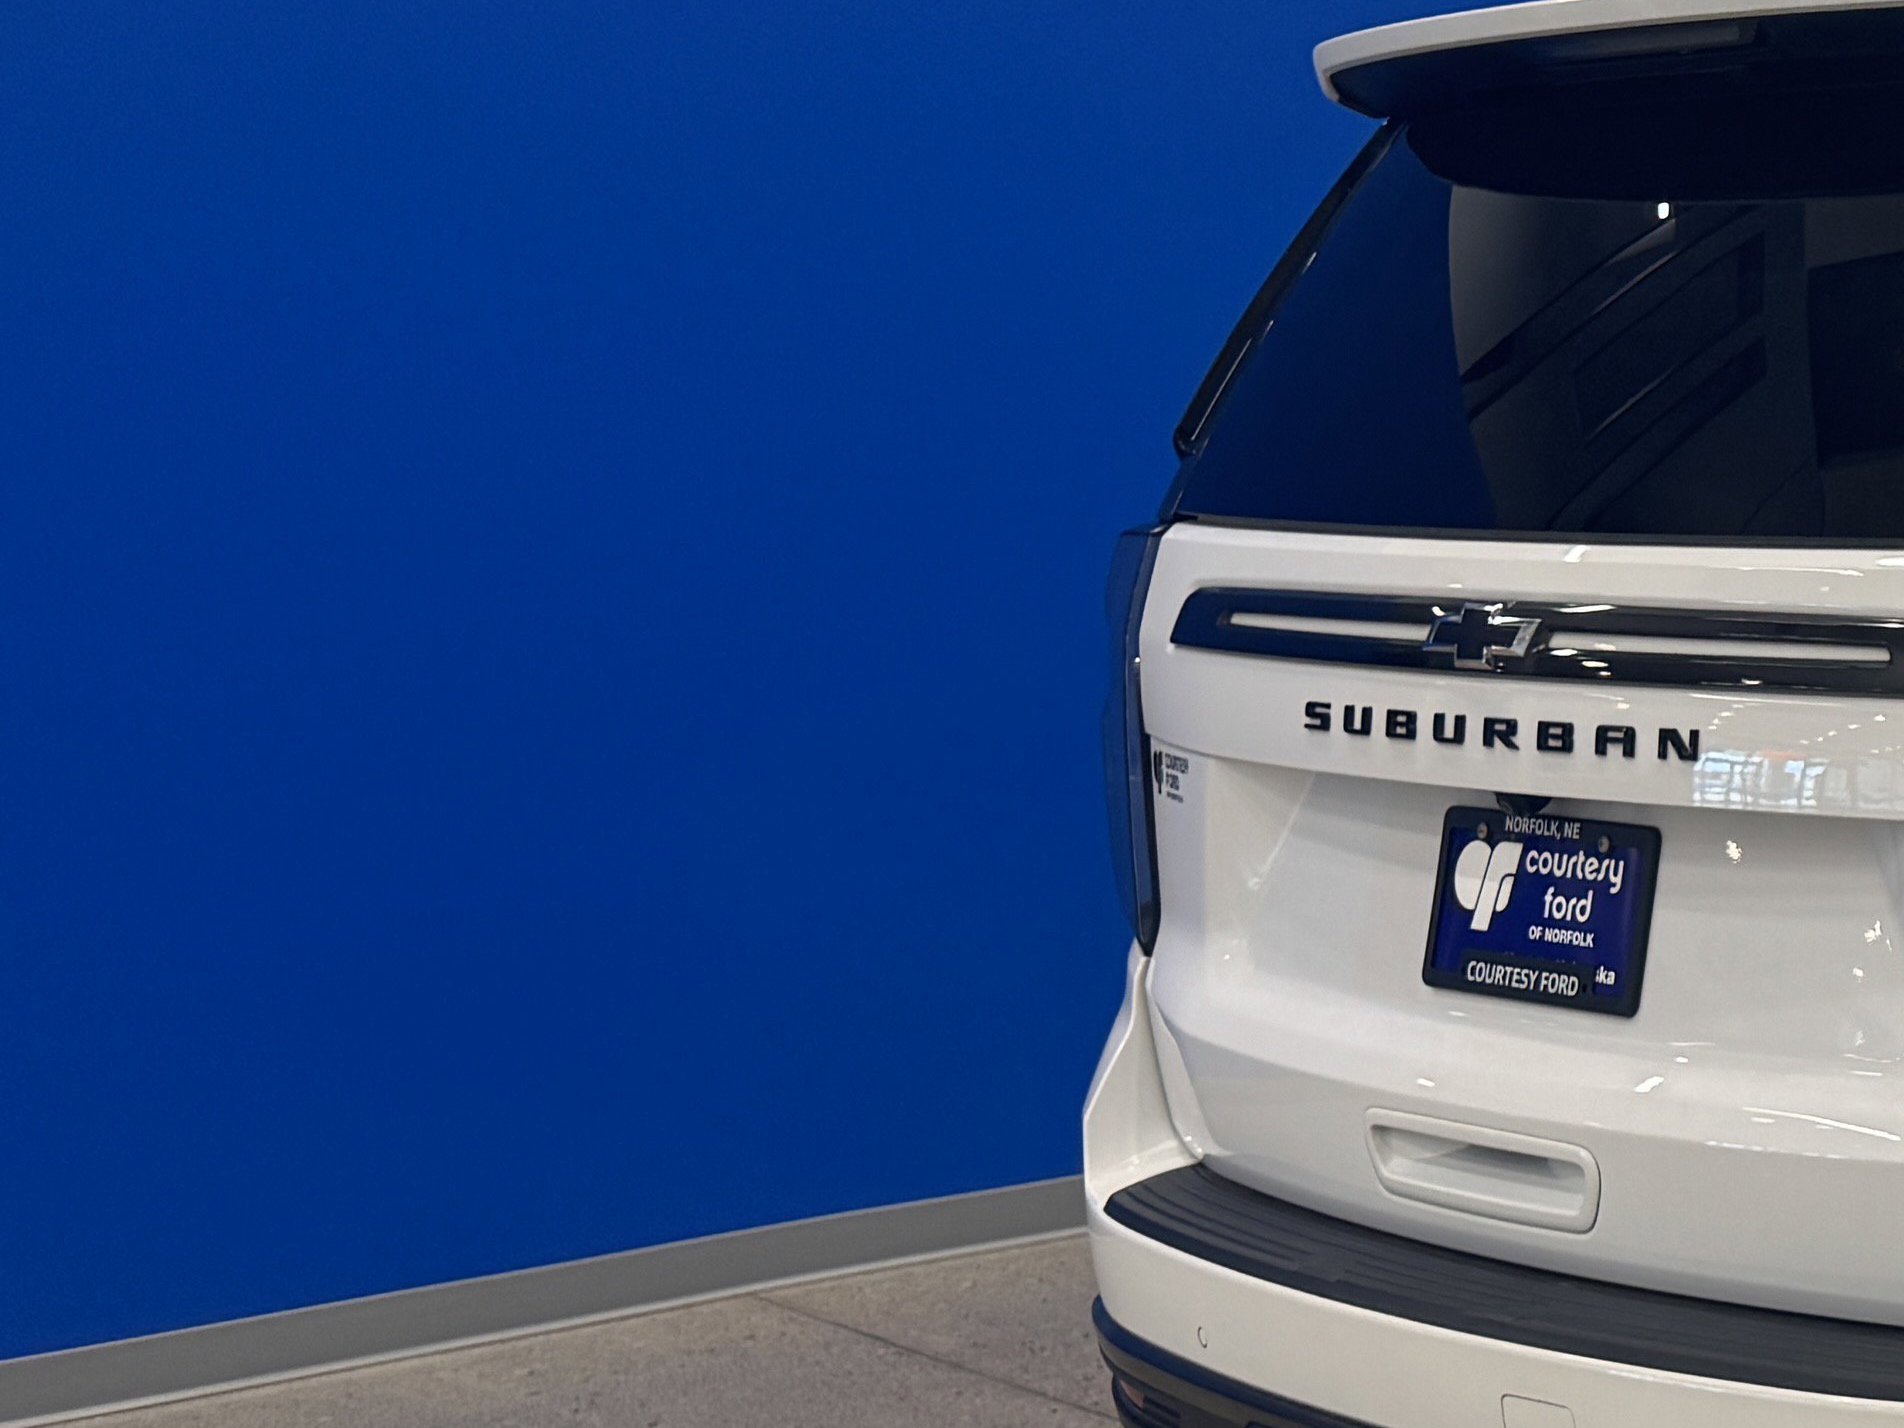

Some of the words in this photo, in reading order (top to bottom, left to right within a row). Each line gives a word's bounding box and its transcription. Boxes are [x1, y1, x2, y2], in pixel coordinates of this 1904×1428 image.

[1304, 701, 1700, 761] SUBURBAN
[1504, 815, 1562, 839] NORFOLK,
[1563, 822, 1581, 839] NE
[1526, 849, 1624, 894] courtesy
[1543, 887, 1594, 923] ford
[1528, 925, 1543, 940] OF
[1544, 928, 1595, 948] NORFOLK
[1466, 960, 1538, 991] COURTESY
[1539, 972, 1580, 996] FORD
